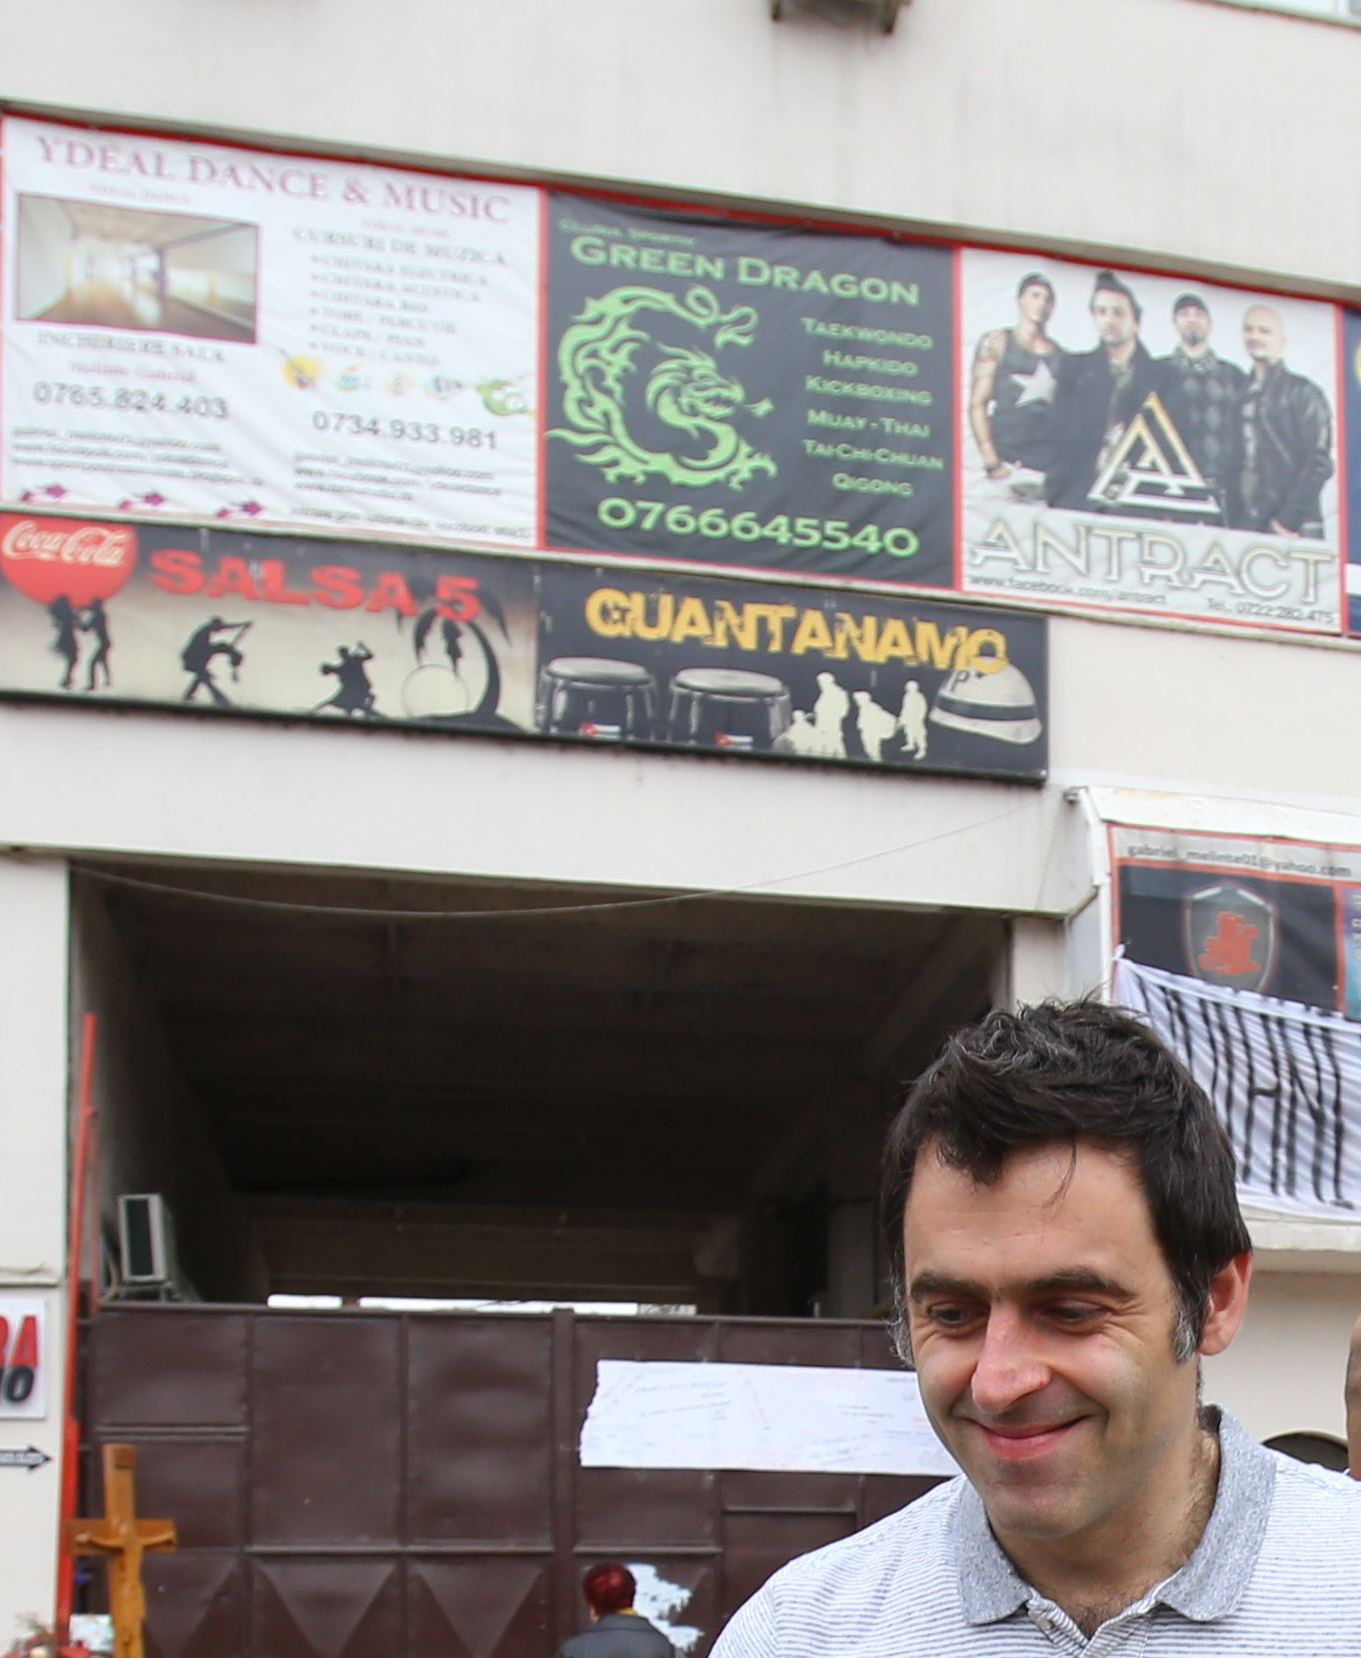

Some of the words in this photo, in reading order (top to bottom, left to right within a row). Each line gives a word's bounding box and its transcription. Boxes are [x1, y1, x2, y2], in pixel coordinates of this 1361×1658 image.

[37, 136, 175, 179] YDEAL
[189, 155, 329, 199] DANCE
[343, 176, 368, 205] &
[381, 181, 511, 224] MUSIC
[570, 235, 725, 280] GREEN
[738, 256, 920, 305] DRAGON
[801, 318, 933, 350] TAEKWONDO
[823, 350, 918, 376] HAPKIDO
[805, 376, 933, 406] KICKBOXING
[311, 410, 497, 449] 0734.933.981
[807, 409, 868, 431] MUAY
[880, 417, 931, 438] THAI
[832, 473, 914, 497] QIGONG
[597, 497, 920, 558] 0766645540
[150, 549, 420, 617] SALSA
[435, 575, 484, 622] 5
[969, 519, 1336, 603] ANTRACT
[584, 588, 1009, 674] GUANTANAMO
